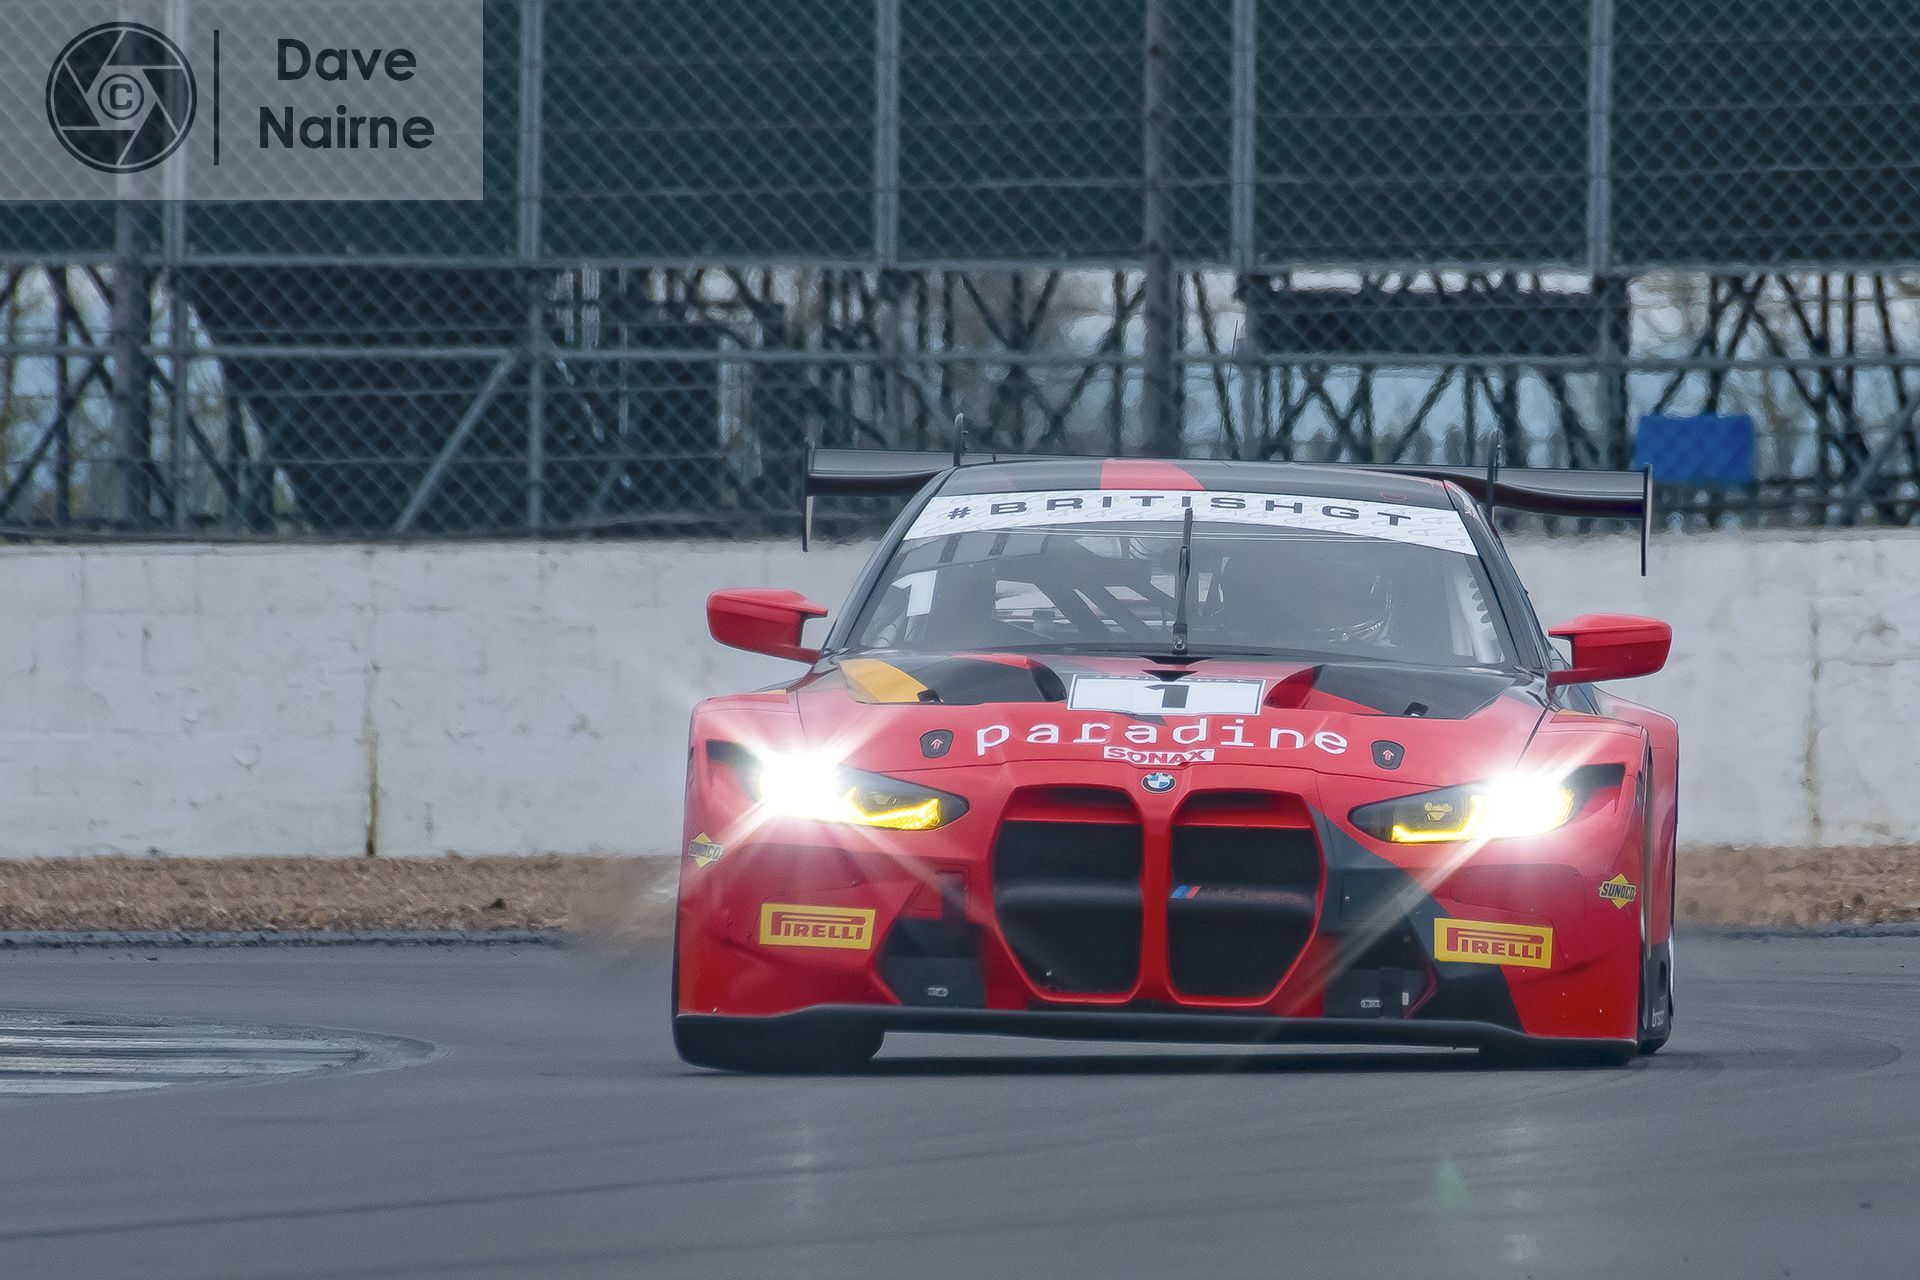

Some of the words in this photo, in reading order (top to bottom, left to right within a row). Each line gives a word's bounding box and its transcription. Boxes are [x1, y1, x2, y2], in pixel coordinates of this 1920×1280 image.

[947, 495, 1411, 527] #BRITISHGT
[891, 570, 937, 617] 1
[1143, 684, 1192, 709] 1
[975, 718, 1348, 756] paradine
[1107, 748, 1208, 764] SONAX
[1600, 882, 1635, 900] SUNOCO
[770, 911, 866, 940] PIRELLI
[1446, 927, 1544, 960] PIRELLI
